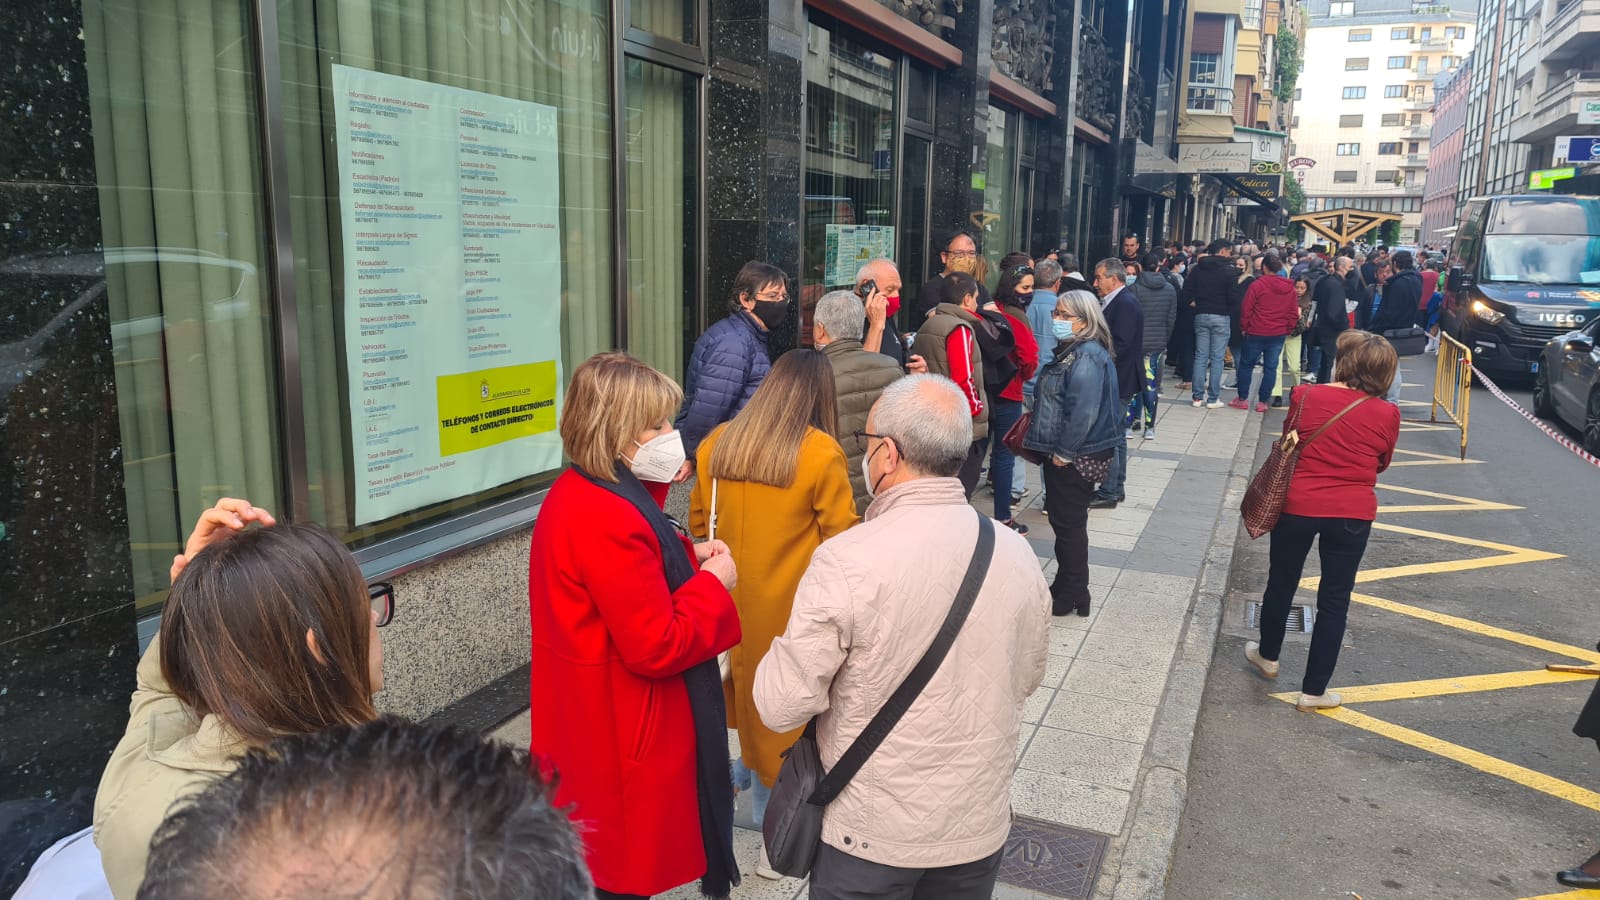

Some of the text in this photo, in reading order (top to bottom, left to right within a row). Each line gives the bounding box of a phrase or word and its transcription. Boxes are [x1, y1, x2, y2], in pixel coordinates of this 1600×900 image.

[1538, 313, 1586, 323] IVECO
[442, 399, 554, 428] TELÉFONOS Y CORREOS ELECTRÓNICOS
[470, 413, 534, 434] DE CONTACTO DIRECTO
